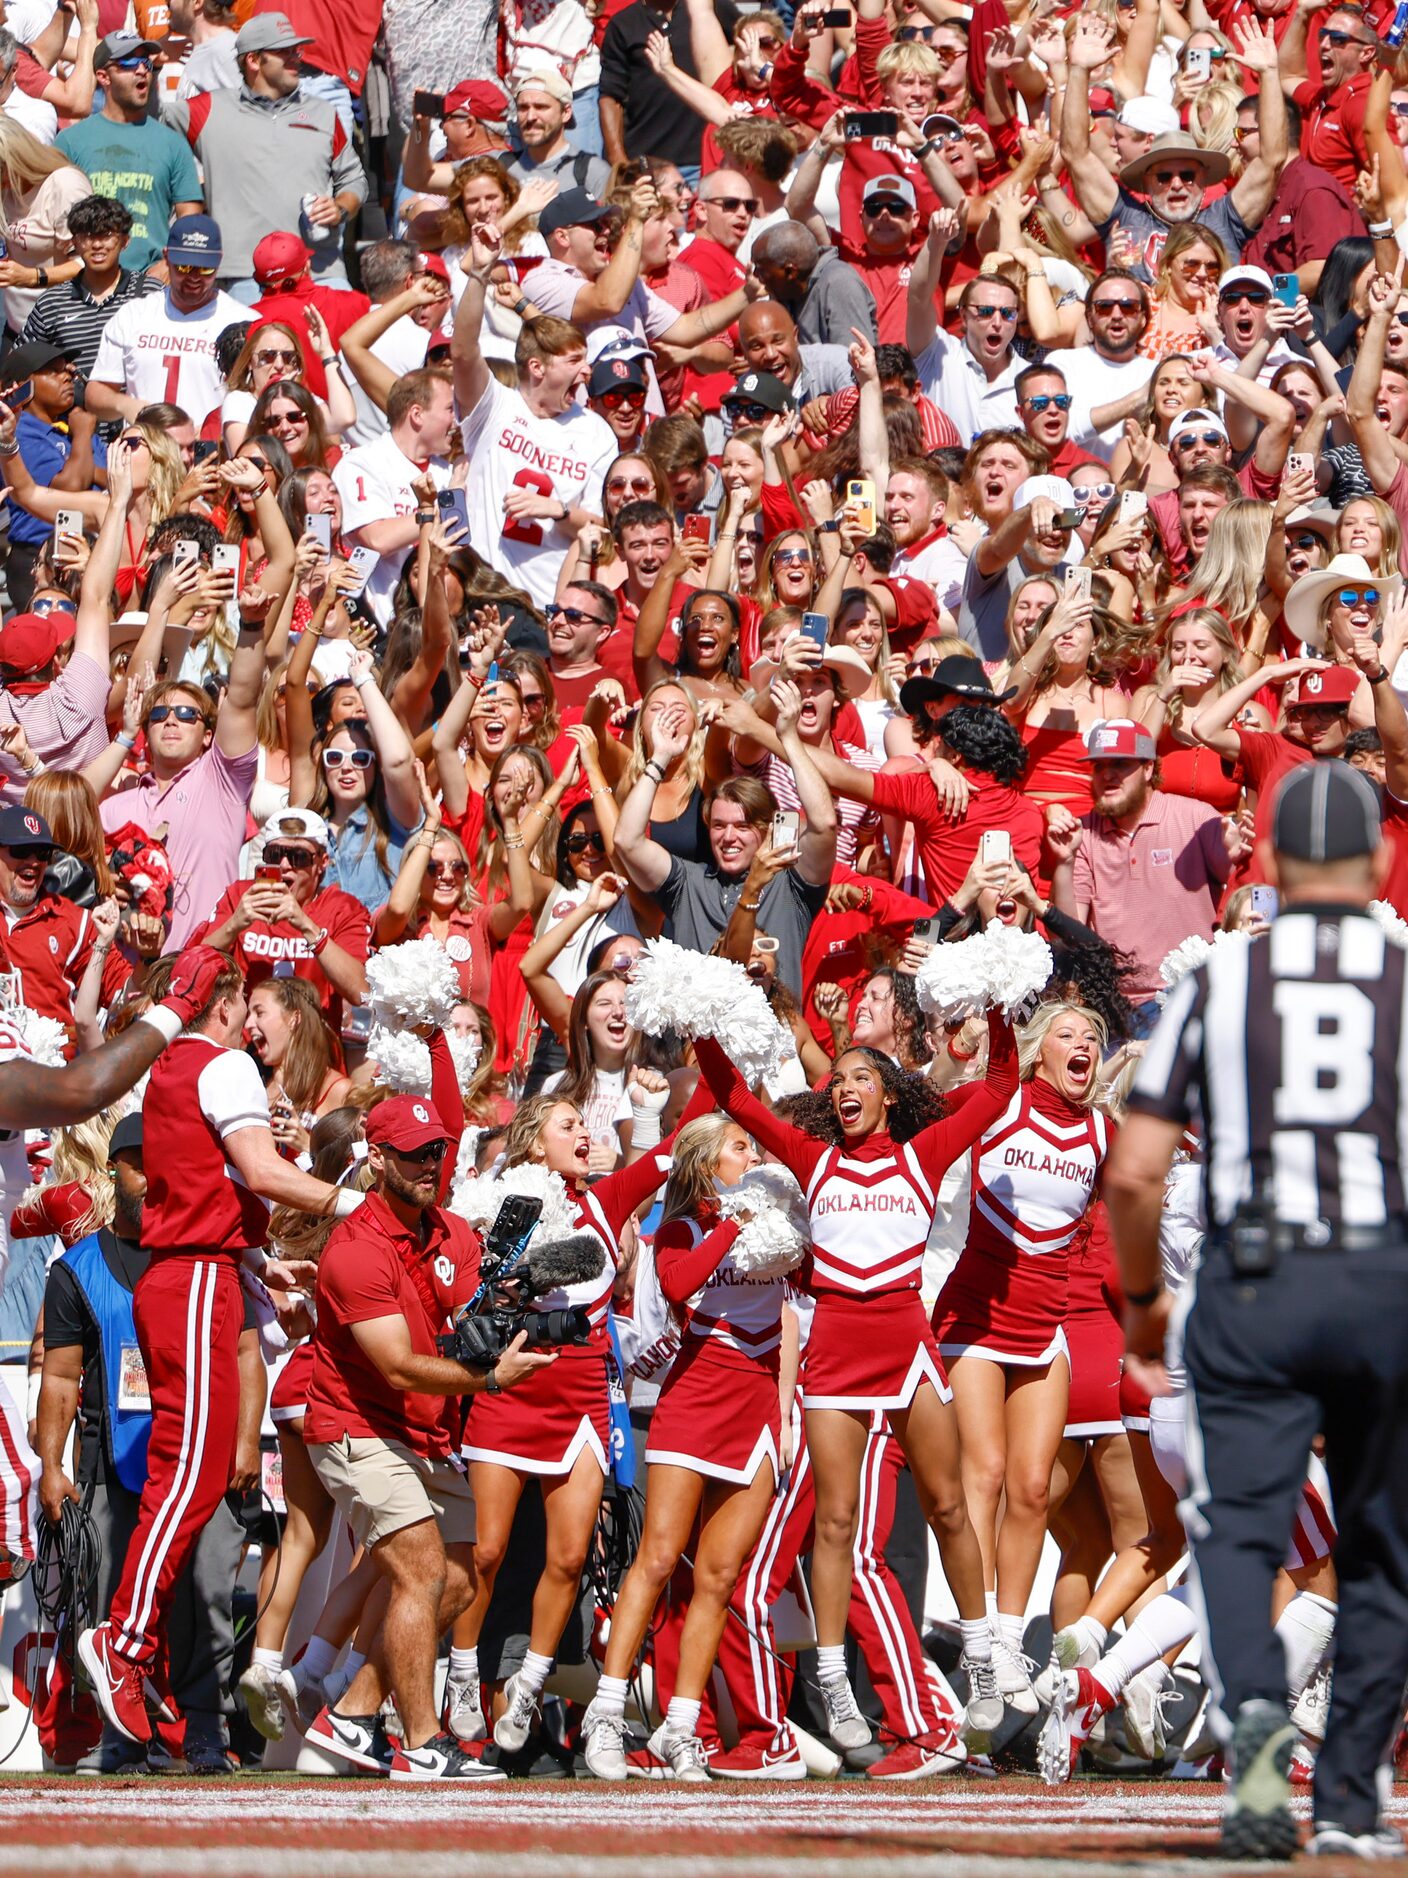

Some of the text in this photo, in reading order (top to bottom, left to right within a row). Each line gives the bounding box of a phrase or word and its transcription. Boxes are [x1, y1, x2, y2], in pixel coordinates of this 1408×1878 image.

[114, 172, 154, 191] NORTH
[138, 334, 216, 356] SOONERS
[501, 427, 587, 481] SOONERS
[356, 477, 367, 501] 1
[24, 815, 42, 835] OU
[1274, 983, 1374, 1124] B
[412, 1104, 430, 1123] OU
[1004, 1147, 1094, 1187] OKLAHOMA
[818, 1193, 917, 1216] OKLAHOMA
[434, 1255, 455, 1286] OU
